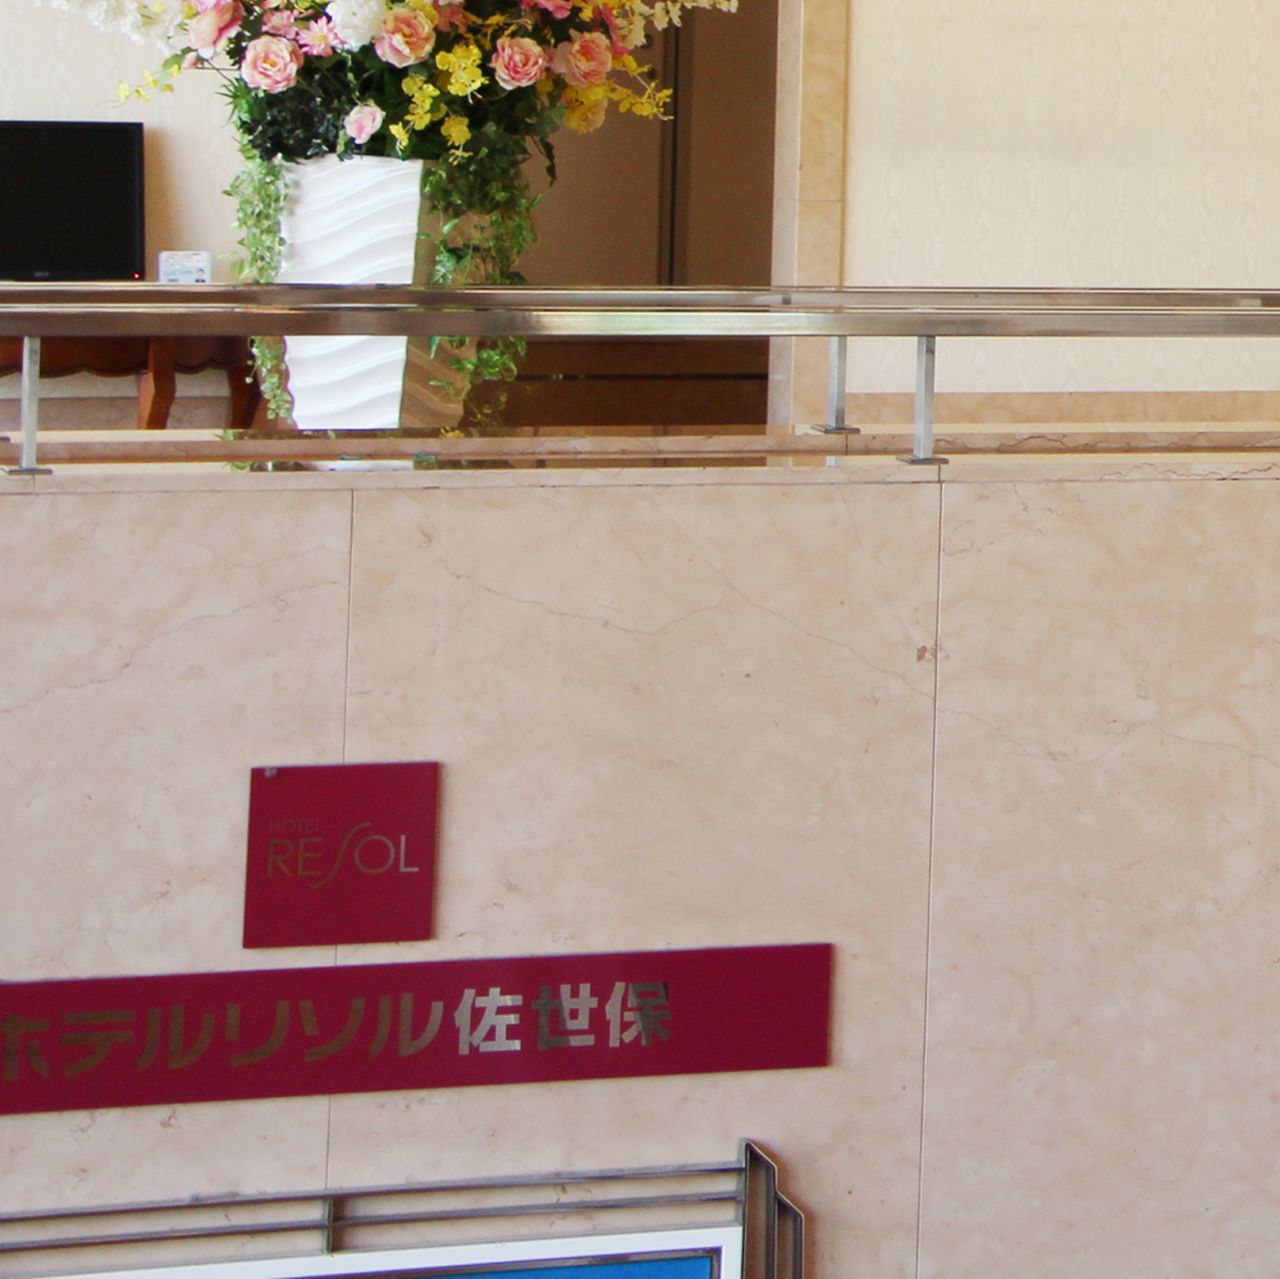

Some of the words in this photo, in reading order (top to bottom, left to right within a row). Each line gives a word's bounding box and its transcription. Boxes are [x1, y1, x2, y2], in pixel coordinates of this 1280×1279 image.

[267, 821, 420, 890] RESOL
[270, 820, 320, 833] HOTEL
[0, 980, 671, 1081] ホテルリソル佐世保
